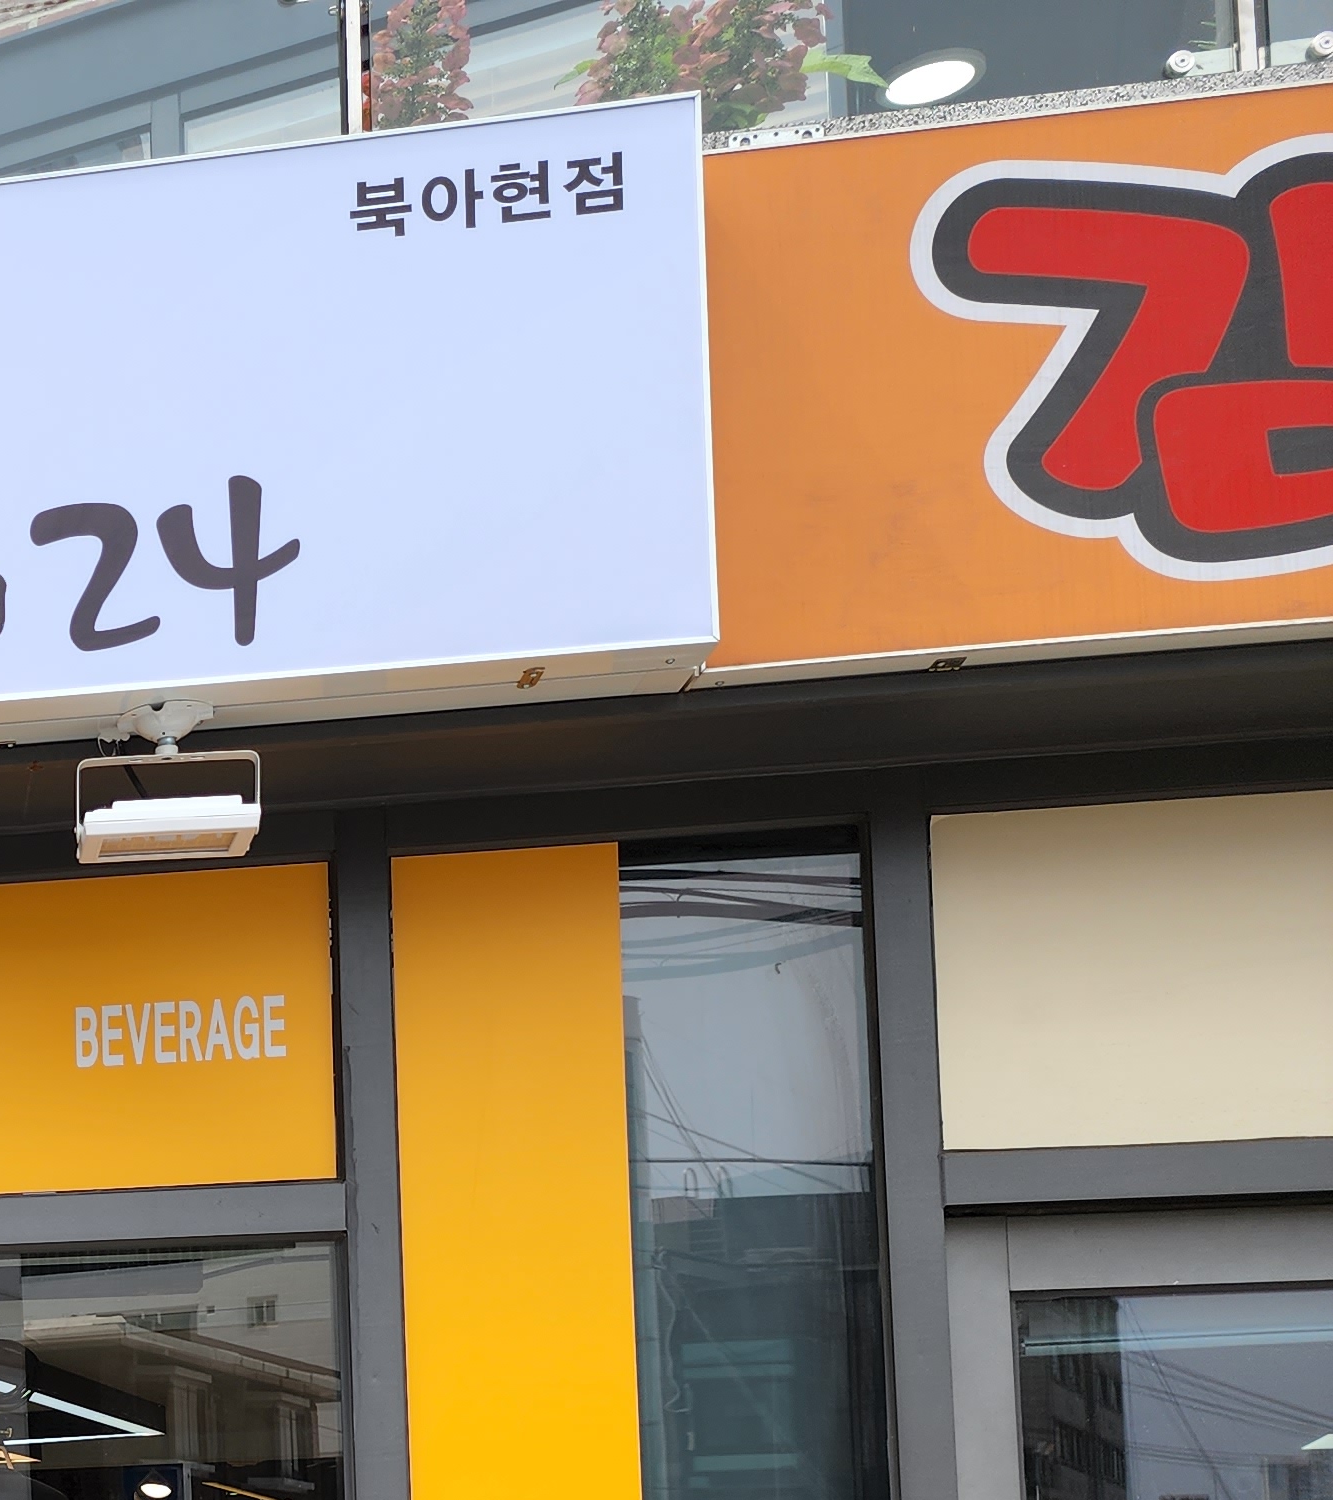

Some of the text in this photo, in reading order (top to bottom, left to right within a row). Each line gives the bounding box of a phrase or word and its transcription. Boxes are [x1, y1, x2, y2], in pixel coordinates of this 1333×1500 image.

[348, 150, 627, 238] 북아현점
[29, 474, 301, 652] 24
[74, 994, 287, 1069] BEVERAGE
